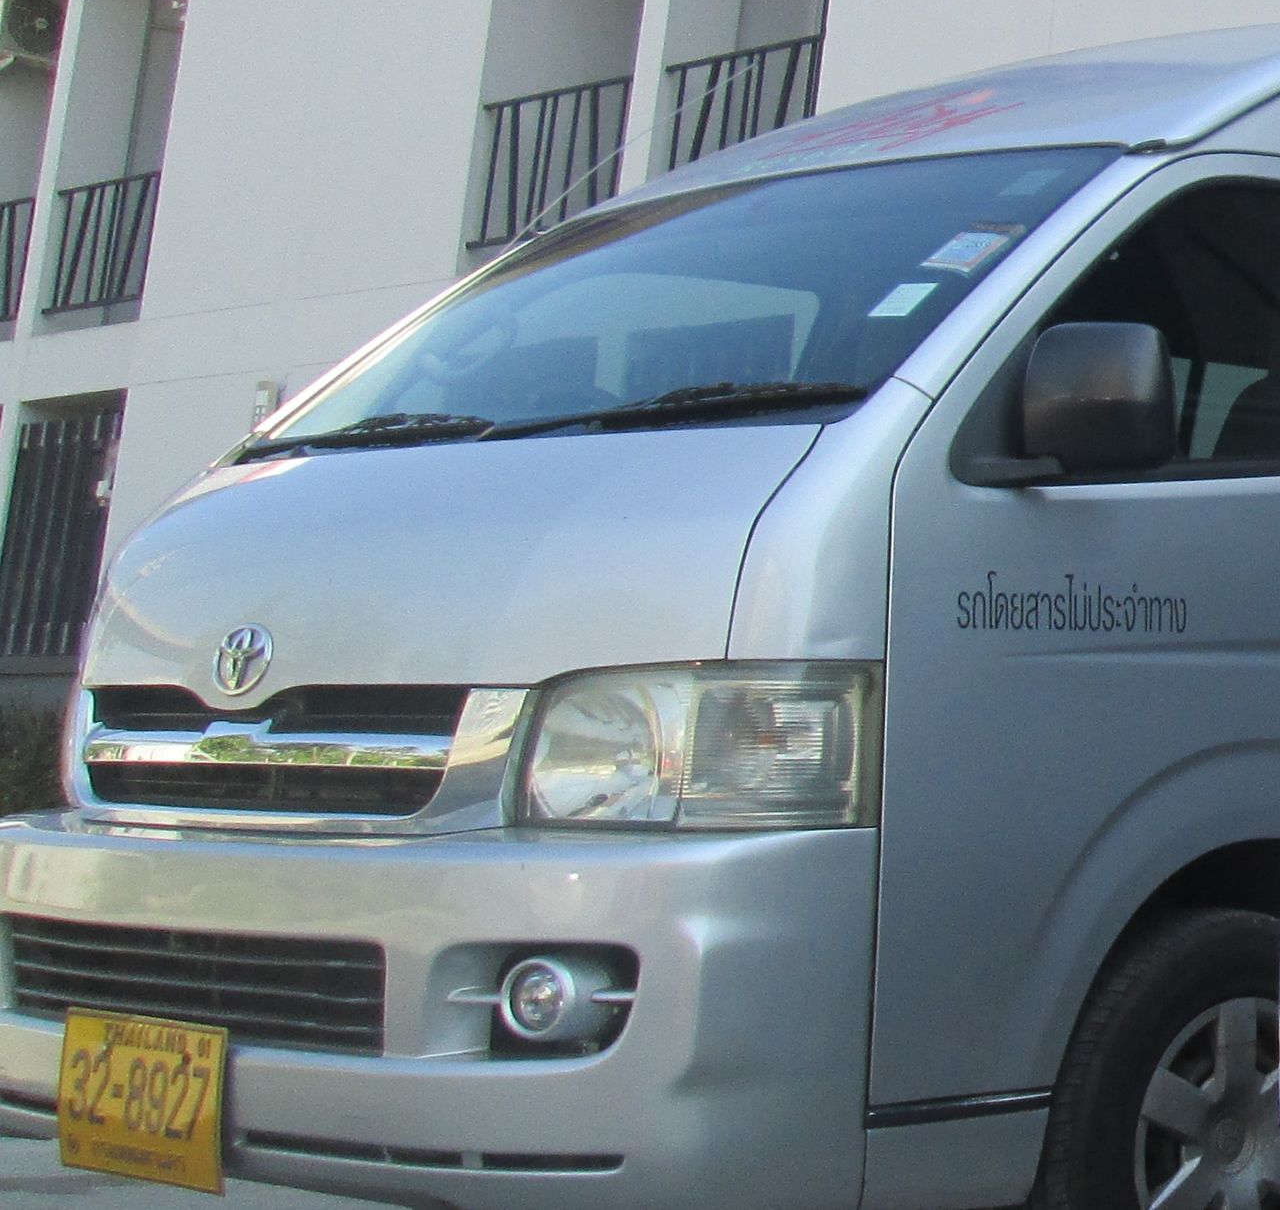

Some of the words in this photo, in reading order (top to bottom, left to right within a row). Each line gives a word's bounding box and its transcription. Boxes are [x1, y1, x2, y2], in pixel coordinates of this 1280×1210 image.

[957, 570, 1187, 633] รถโดยสารไม่ประจำทาง
[72, 1047, 212, 1140] 32-8927
